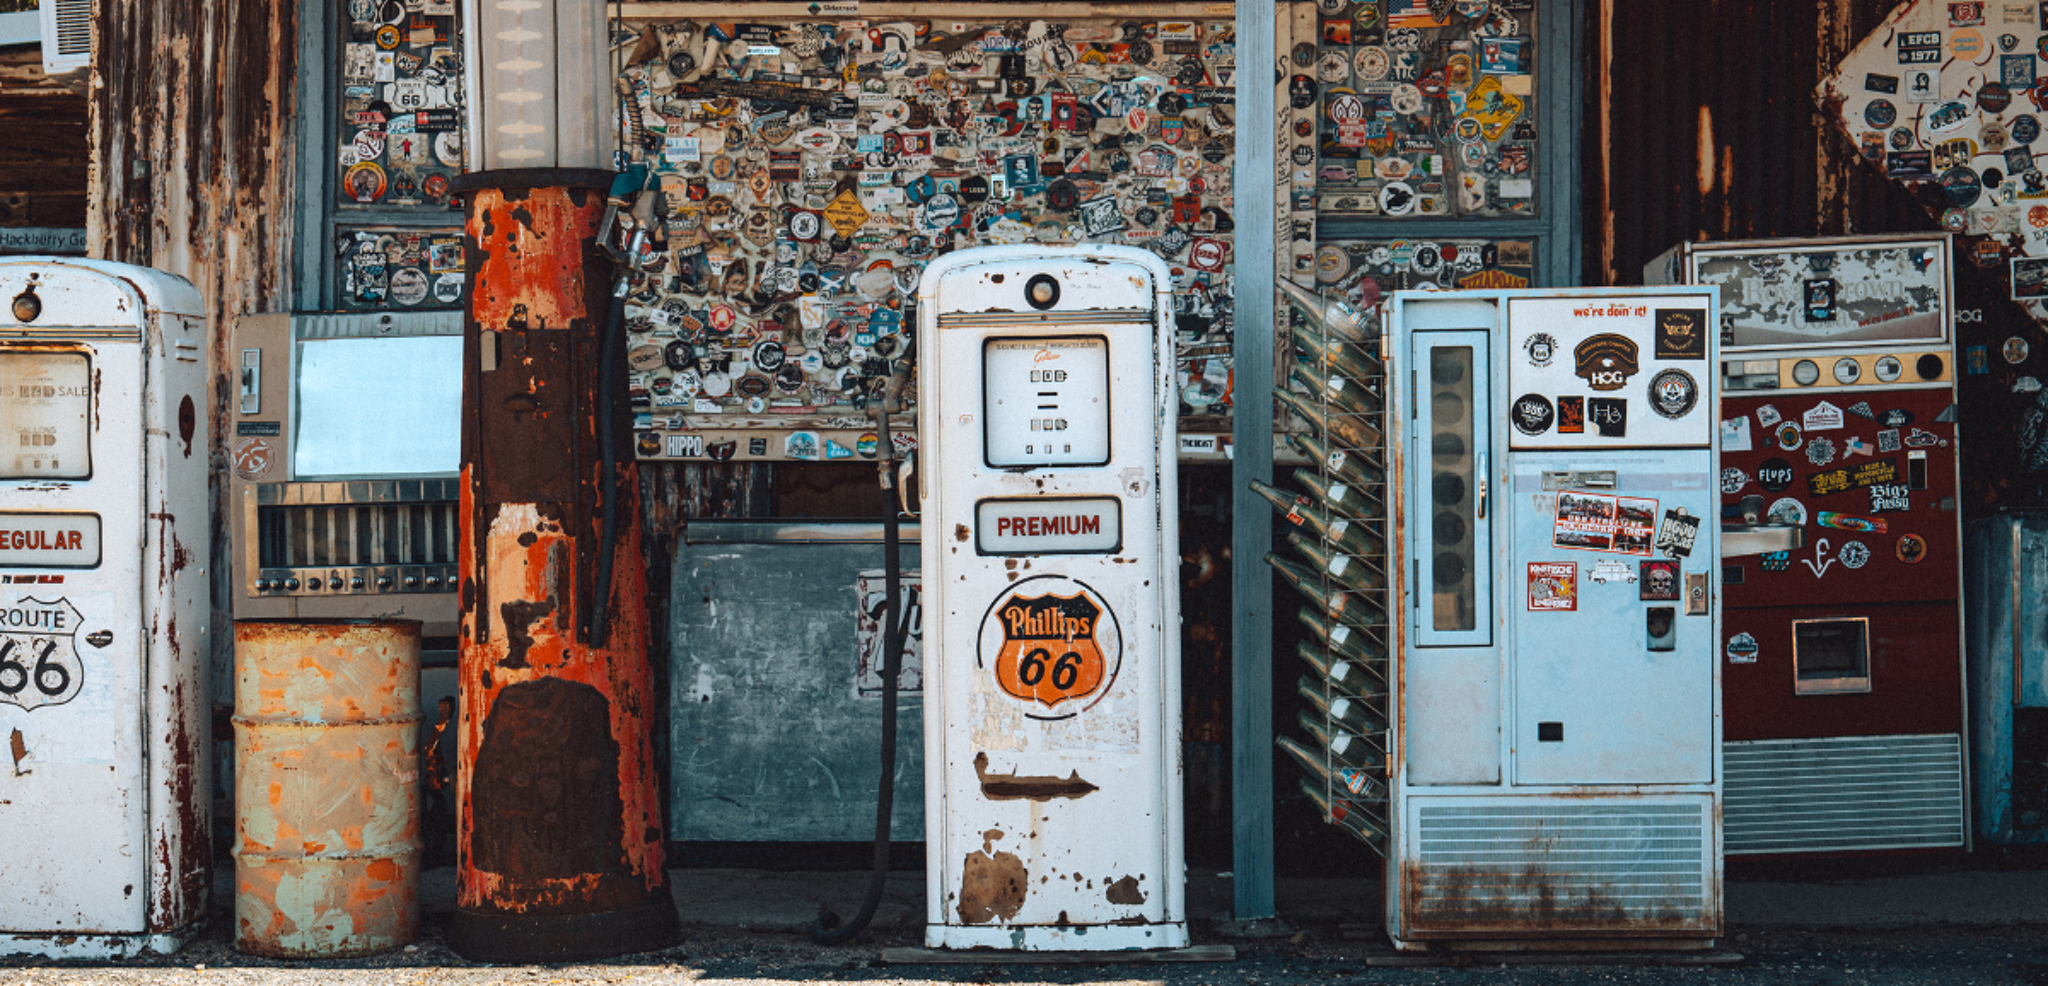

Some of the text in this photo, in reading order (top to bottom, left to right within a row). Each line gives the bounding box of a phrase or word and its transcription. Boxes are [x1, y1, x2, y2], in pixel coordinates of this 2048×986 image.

[1908, 33, 1940, 45] EFCB
[1911, 50, 1938, 61] 1977
[401, 94, 421, 106] 66
[0, 233, 65, 248] Hackberry
[1742, 279, 1804, 308] Roya
[1574, 305, 1647, 317] we're doin' it!
[1591, 371, 1624, 385] HOG
[58, 386, 88, 397] SALE
[667, 435, 703, 457] HIPPO
[997, 514, 1100, 537] PREMIUM
[1004, 605, 1091, 642] Phillips
[0, 639, 70, 696] 66
[1019, 648, 1083, 690] 66
